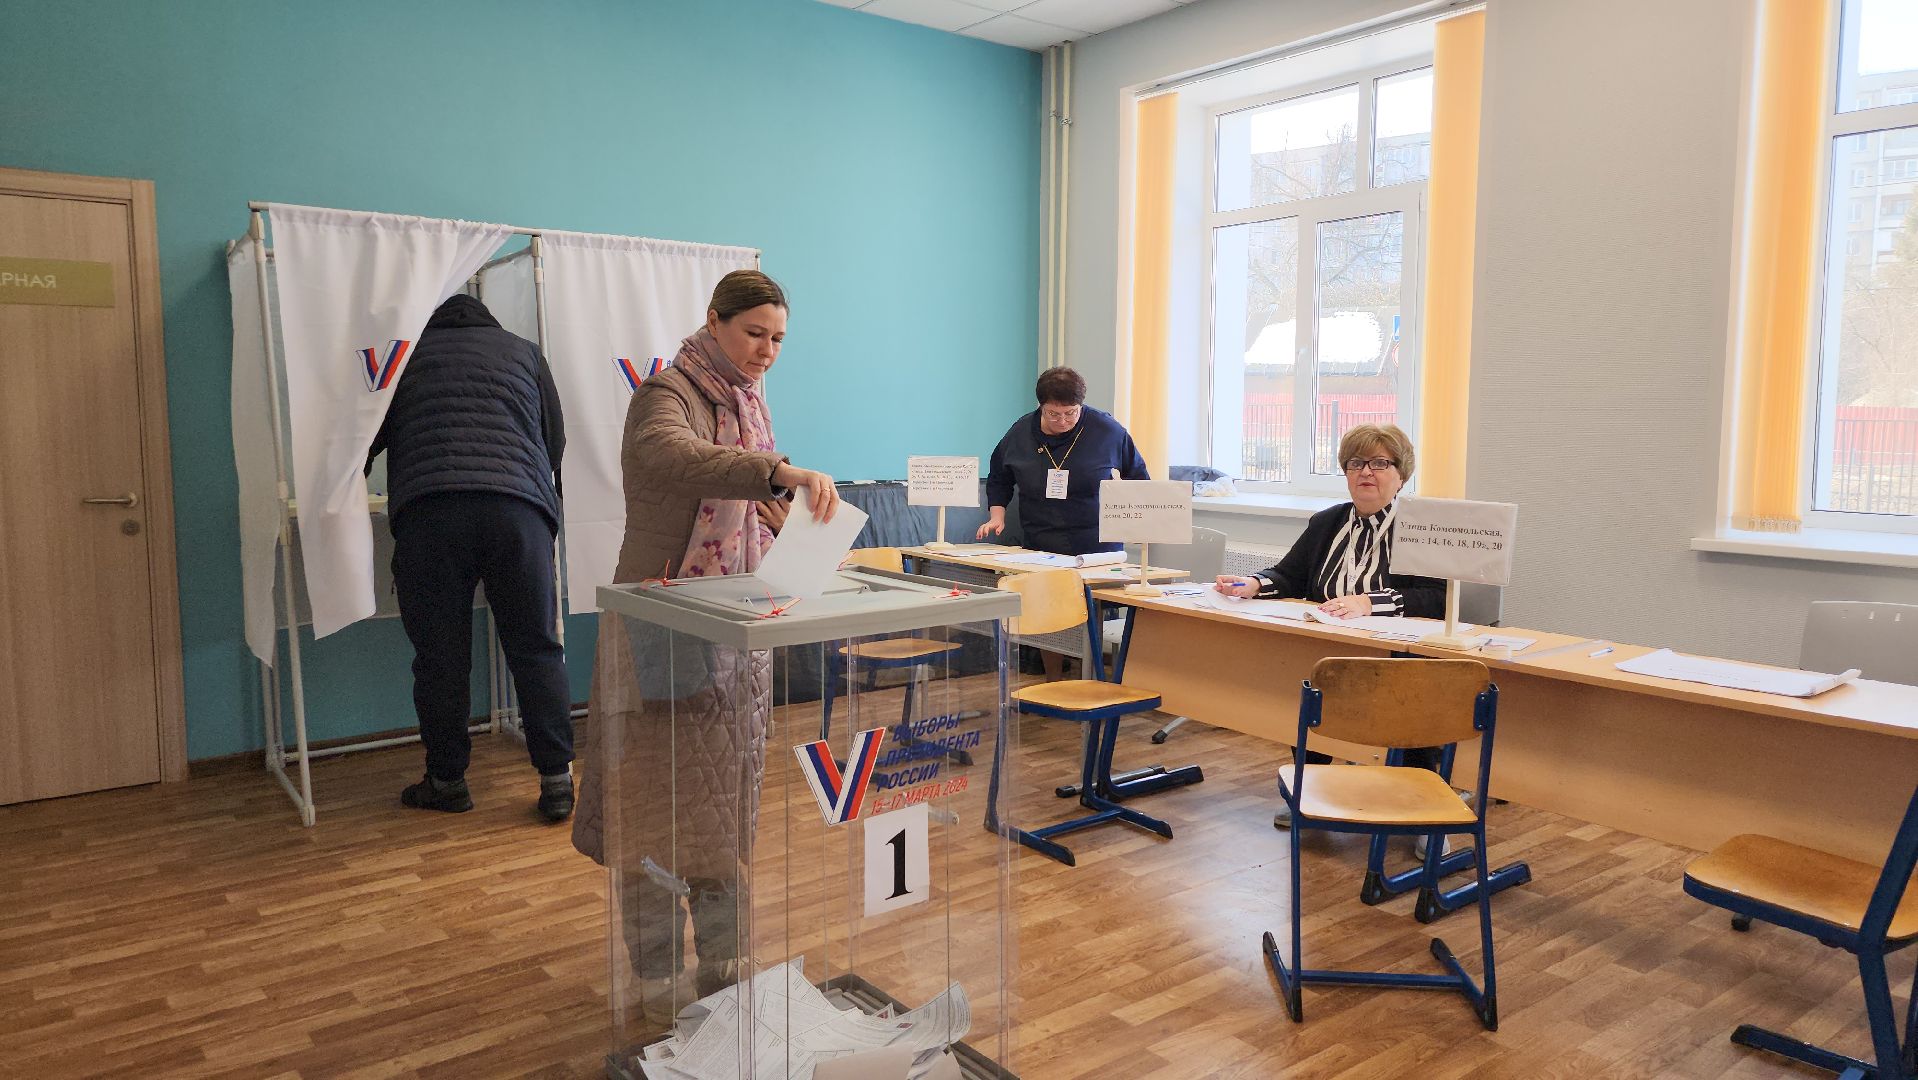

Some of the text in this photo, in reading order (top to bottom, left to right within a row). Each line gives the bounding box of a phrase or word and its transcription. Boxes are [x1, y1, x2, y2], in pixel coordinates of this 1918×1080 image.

[0, 272, 57, 289] РНАЯ
[1400, 521, 1503, 537] Улица Комсомольская,
[1427, 537, 1440, 546] 14,
[1442, 538, 1454, 547] 16,
[1457, 539, 1470, 549] 18,
[1492, 542, 1504, 551] 20
[892, 713, 960, 742] ВЫБОРЫ
[876, 762, 940, 792] РОССИИ
[905, 783, 941, 804] МАРТА
[943, 775, 969, 797] 2024
[885, 828, 914, 901] 1
